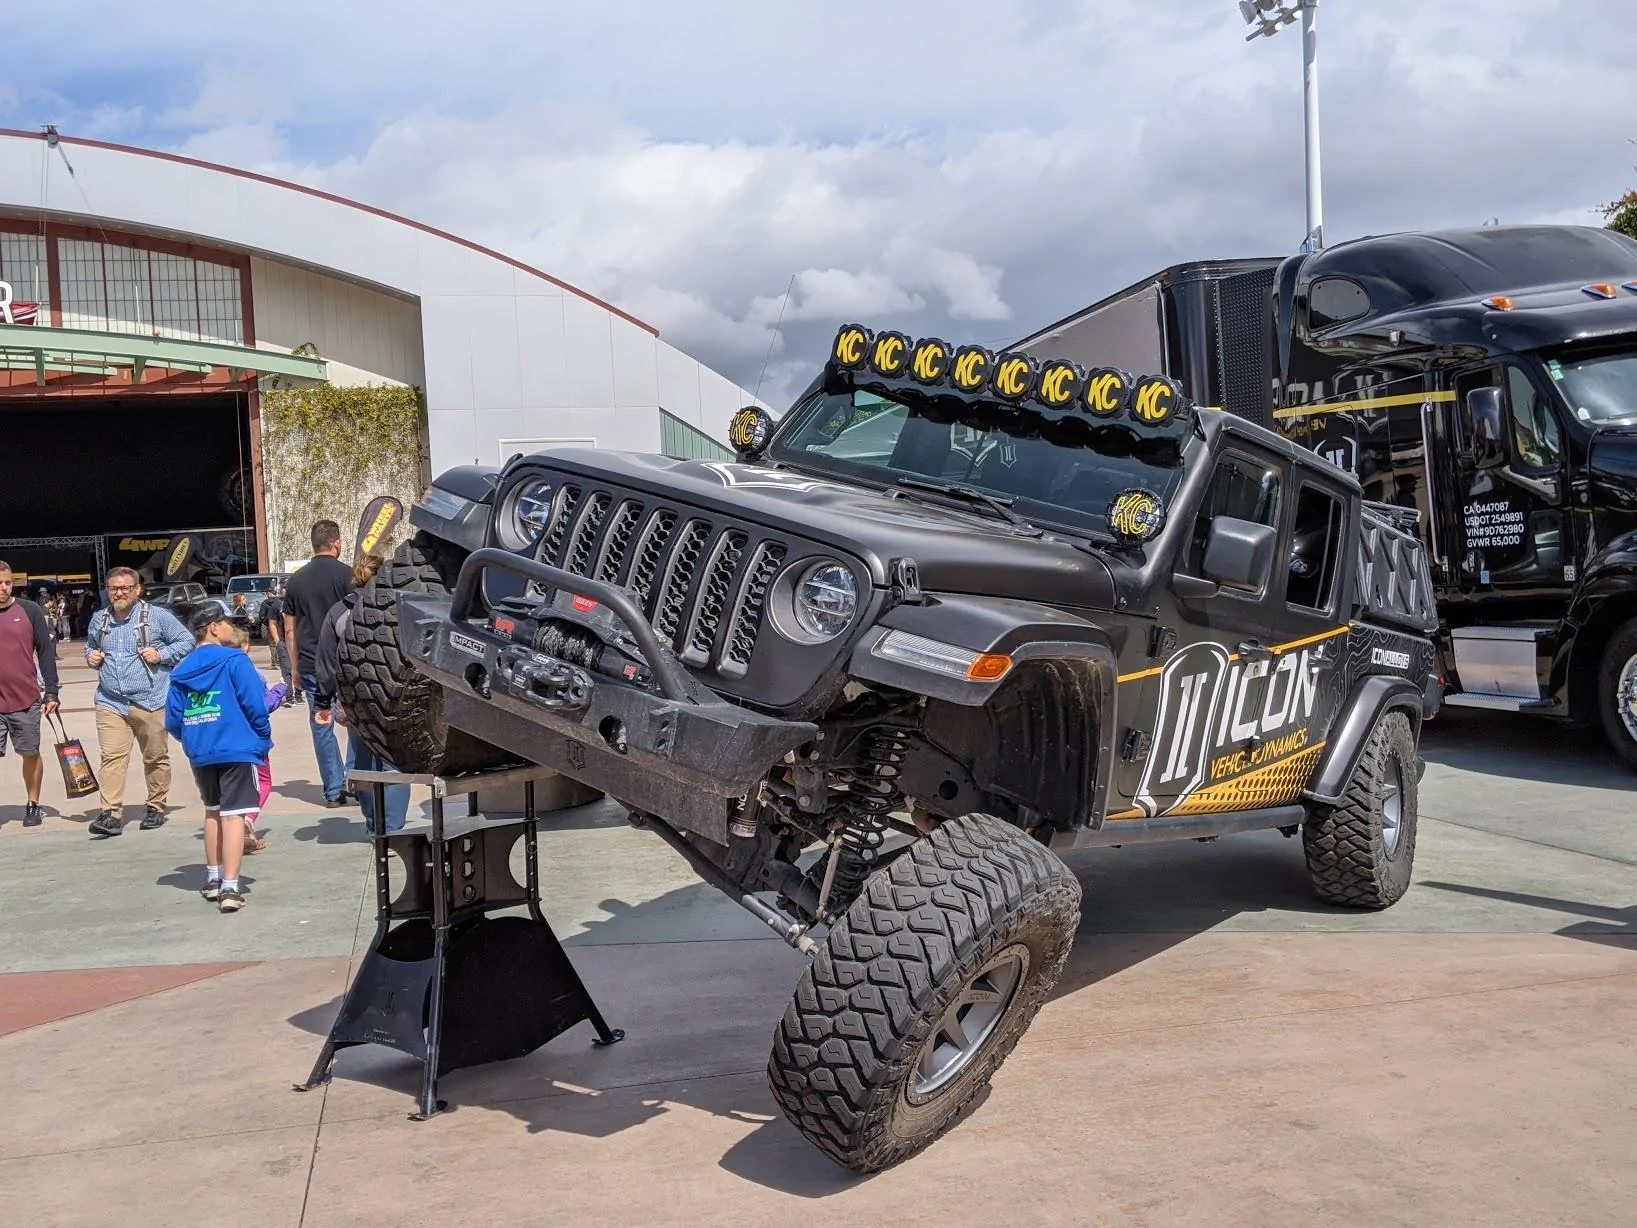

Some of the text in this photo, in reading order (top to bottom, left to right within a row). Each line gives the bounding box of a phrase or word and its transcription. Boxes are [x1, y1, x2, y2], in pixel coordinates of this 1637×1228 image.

[837, 329, 864, 364] KC
[874, 336, 903, 371] KC
[913, 343, 943, 378] KC
[954, 351, 985, 386] KC
[997, 358, 1029, 395] KC
[1041, 366, 1074, 402] KC
[1088, 373, 1121, 410] KC
[1135, 381, 1171, 419] KC
[731, 410, 757, 446] KC
[1111, 494, 1152, 535] KC
[1463, 501, 1509, 515] CA 0447087
[1464, 512, 1523, 526] USDOT 2549891
[1466, 523, 1525, 537] VIN#9D762980
[1466, 535, 1520, 548] GVWR 65,000
[1565, 569, 1574, 580] 65
[1215, 645, 1325, 748] ICON
[1252, 727, 1308, 764] DYNAMICS
